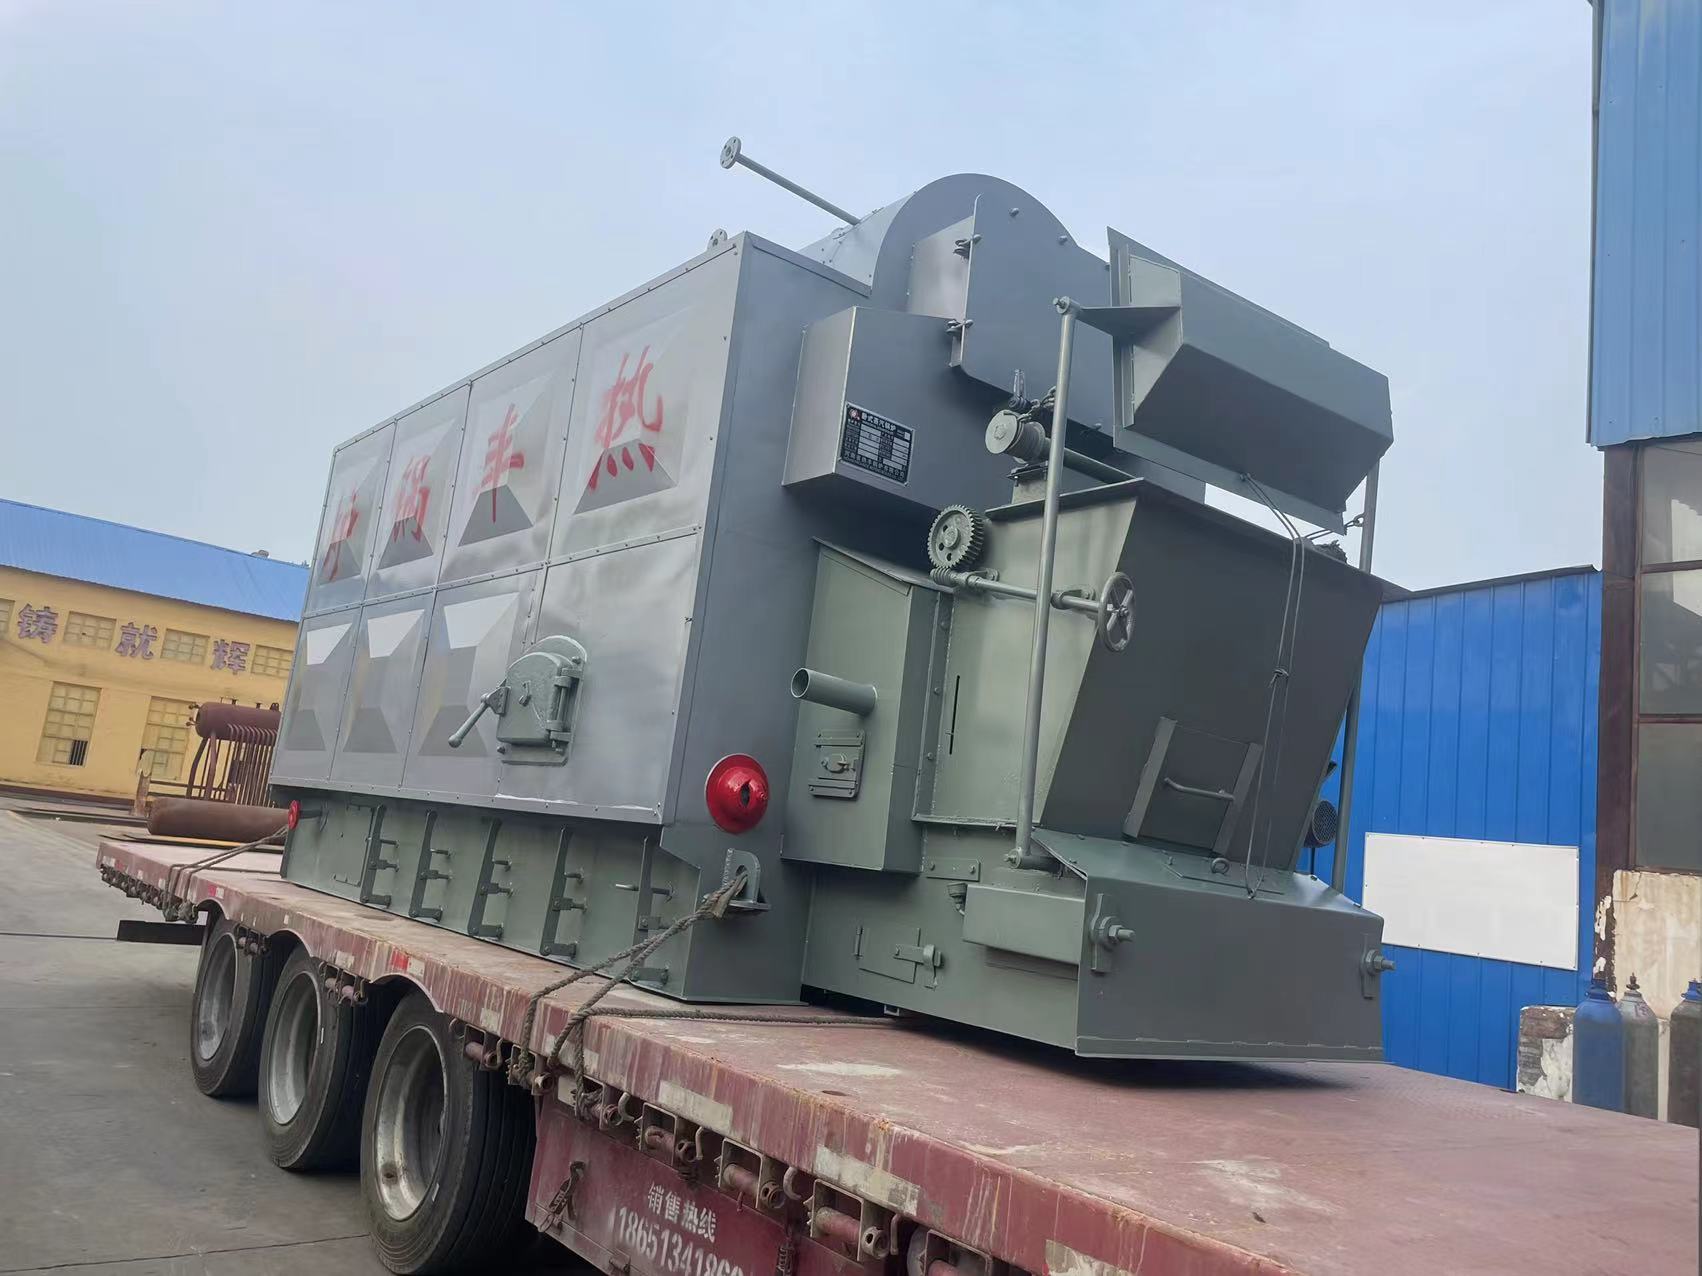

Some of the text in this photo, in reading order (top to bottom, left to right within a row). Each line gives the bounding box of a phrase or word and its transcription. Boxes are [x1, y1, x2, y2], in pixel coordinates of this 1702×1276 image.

[16, 603, 251, 676] 铸就辉
[618, 1206, 744, 1276] 186513418
[647, 1181, 717, 1243] 销售热线
